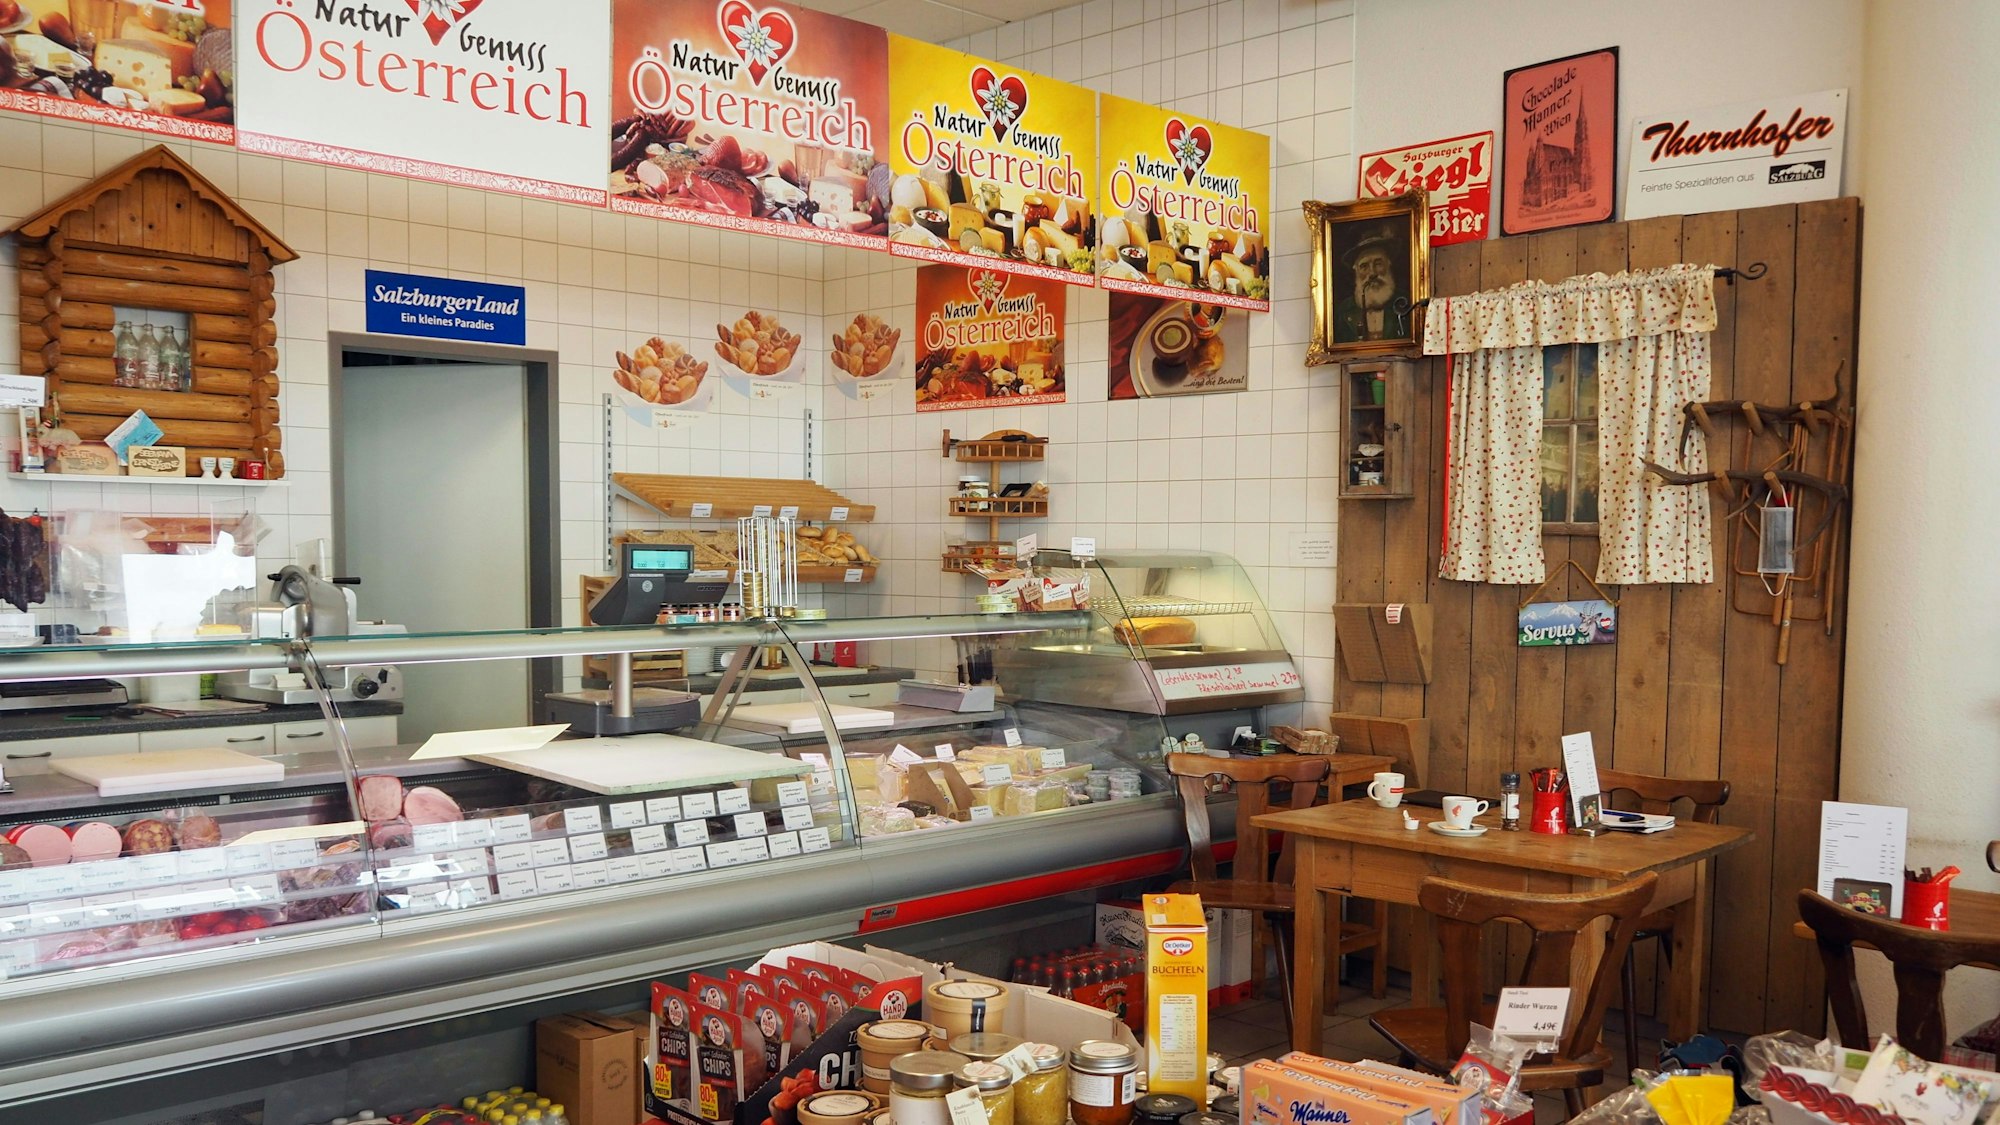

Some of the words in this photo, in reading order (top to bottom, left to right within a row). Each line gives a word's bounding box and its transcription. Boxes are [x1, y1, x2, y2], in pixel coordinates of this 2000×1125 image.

[315, 0, 410, 38] Natur
[459, 22, 547, 73] Genuss
[255, 0, 592, 129] Österreich
[672, 43, 739, 80] Natur
[773, 66, 839, 107] Genuss
[632, 50, 872, 152] Österreich
[934, 105, 986, 138] Natur
[1012, 122, 1061, 160] Genuss
[1543, 112, 1572, 136] Wien
[1641, 106, 1835, 163] Thurnhofer
[902, 112, 1085, 199] Österreich
[1402, 145, 1464, 163] Salzburger
[1135, 154, 1179, 182] Natur
[1198, 169, 1240, 199] Genuss
[1364, 140, 1486, 198] Stiegl
[1640, 182, 1673, 194] Feinste
[1674, 175, 1735, 191] Spezialitäten
[1738, 173, 1756, 183] aus
[1110, 161, 1260, 235] Österreich
[1430, 206, 1485, 237] Bier
[372, 284, 520, 316] SalzburgerLand
[944, 301, 980, 319] Natur
[997, 293, 1035, 314] Genuss
[400, 312, 417, 324] Ein
[418, 314, 454, 327] kleines
[454, 317, 495, 331] Paradies
[924, 304, 1056, 350] Österreich
[1521, 621, 1576, 643] Servus
[1151, 965, 1205, 975] BUCHTELN
[882, 1001, 906, 1015] HANDL
[1507, 1001, 1531, 1010] Rinder
[1532, 1002, 1558, 1010] Wurzen
[1532, 1021, 1558, 1031] 4,49€
[661, 1037, 687, 1056] CHIPS
[655, 1064, 669, 1084] 80%
[702, 1057, 731, 1077] CHIPS
[700, 1084, 717, 1105] 80%
[1289, 1099, 1351, 1124] Manner
